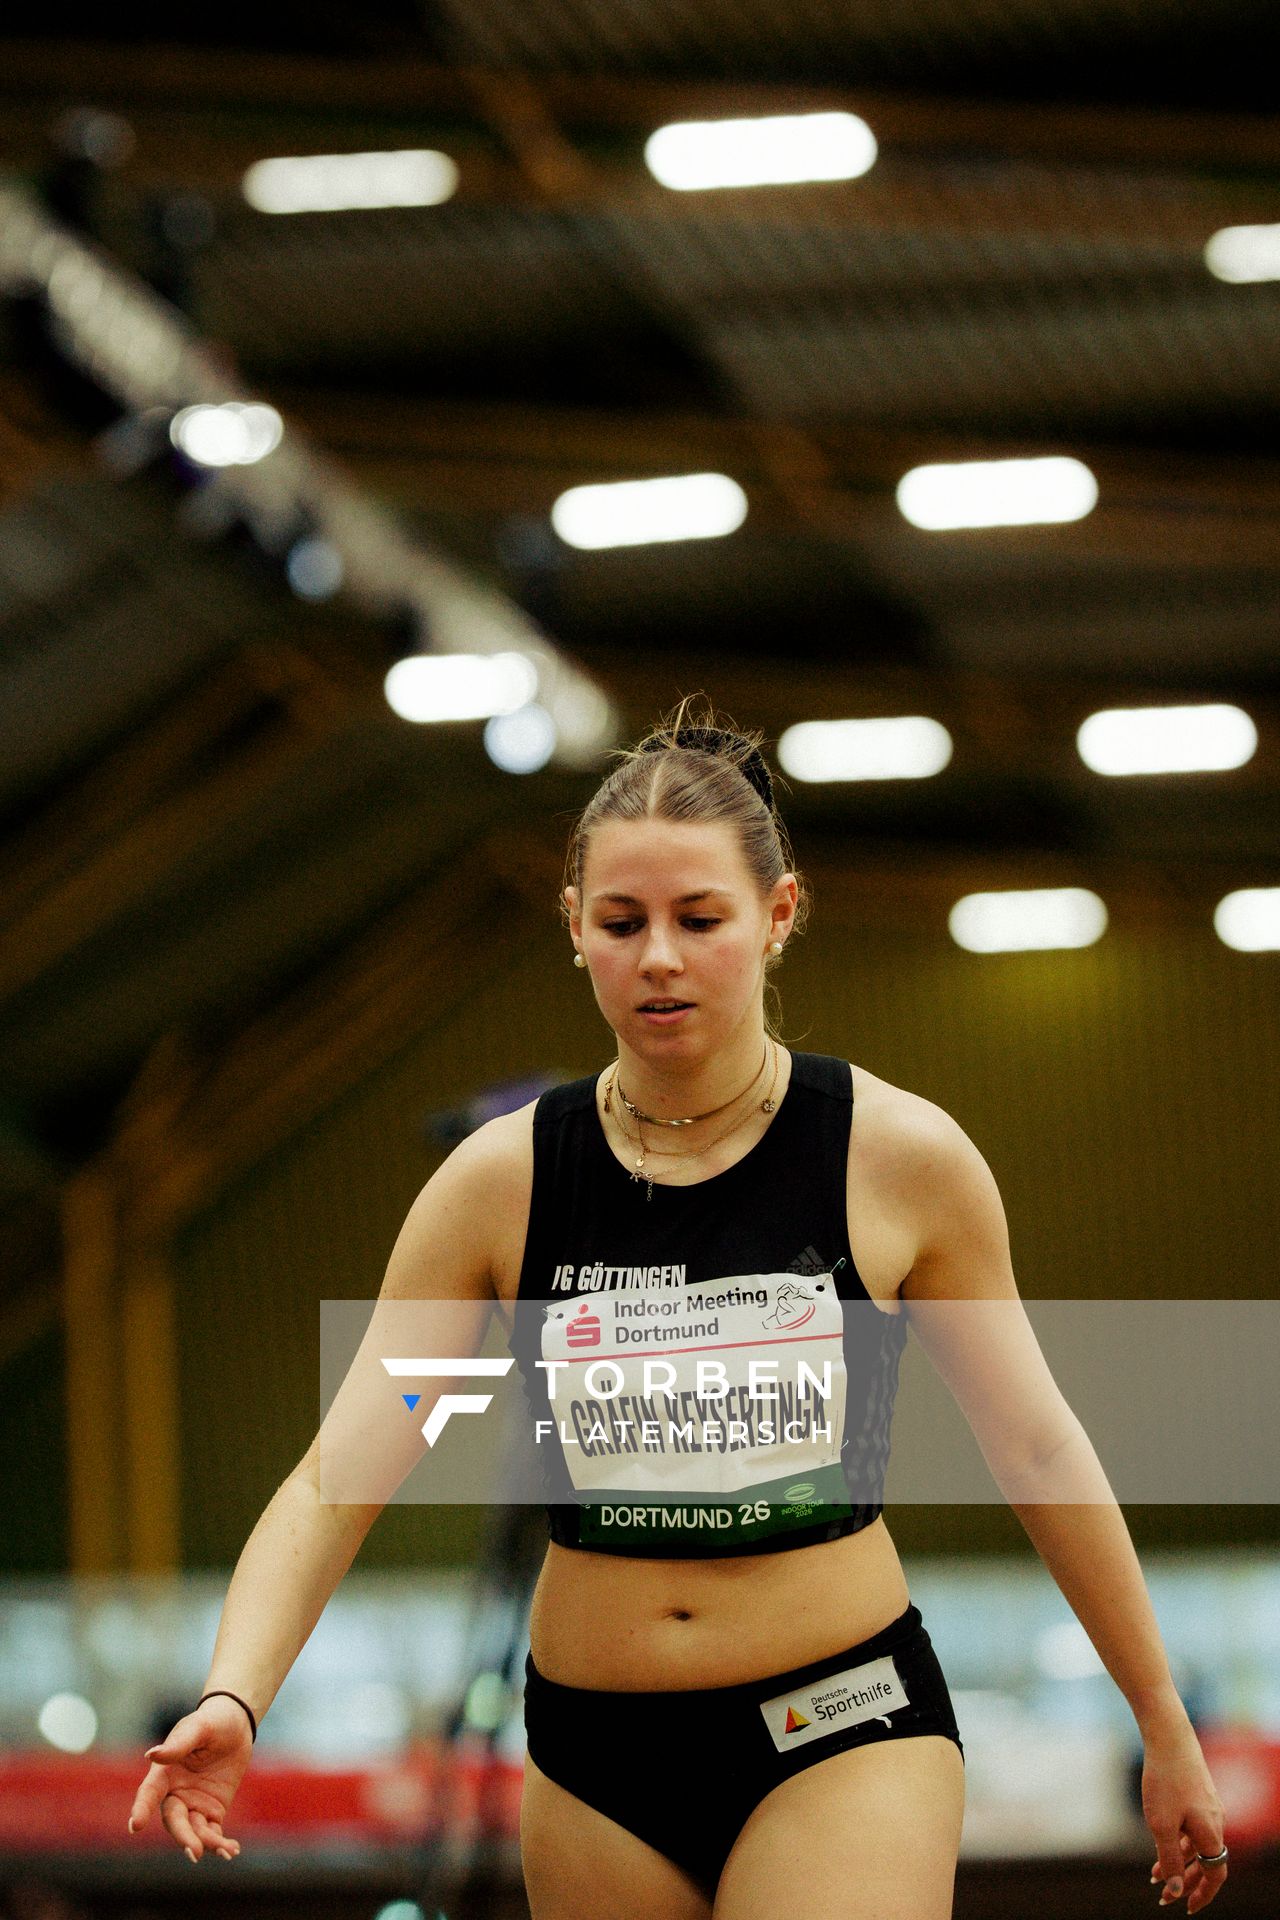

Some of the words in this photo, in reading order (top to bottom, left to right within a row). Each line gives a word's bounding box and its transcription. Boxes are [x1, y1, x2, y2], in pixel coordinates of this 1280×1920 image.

[577, 1261, 687, 1292] GÖTTINGEN
[614, 1298, 682, 1319] Indoor
[686, 1286, 768, 1313] Meeting
[615, 1317, 719, 1345] Dortmund
[570, 1379, 666, 1458] GRÄFIN
[601, 1505, 733, 1529] DORTMUND
[737, 1500, 771, 1526] 26
[810, 1686, 849, 1706] Deutsche
[814, 1682, 893, 1721] Sporthilfe
